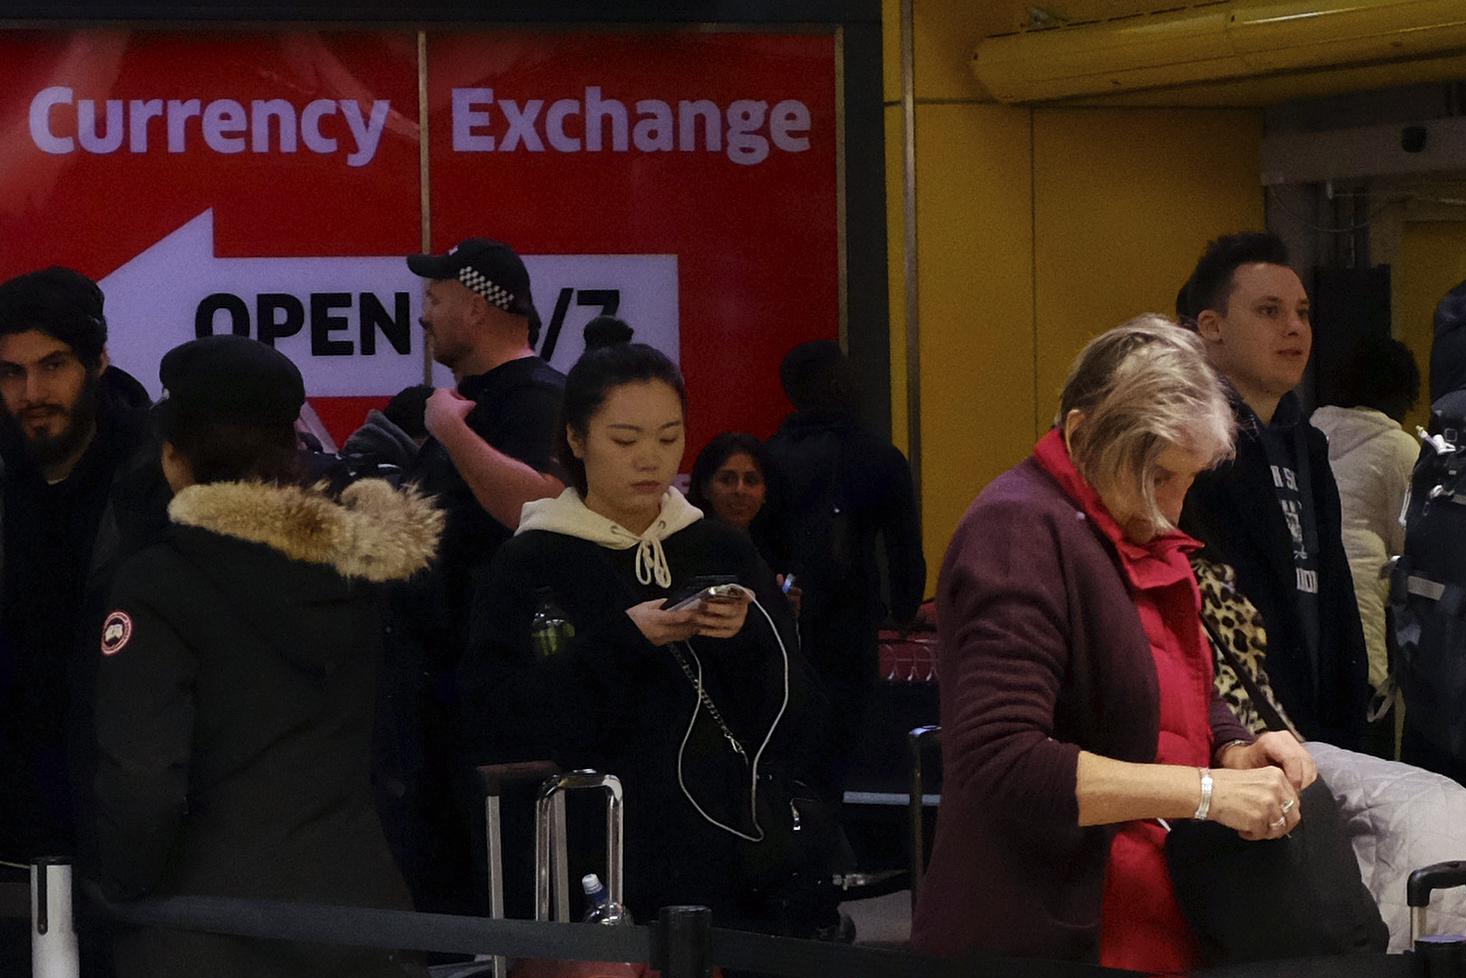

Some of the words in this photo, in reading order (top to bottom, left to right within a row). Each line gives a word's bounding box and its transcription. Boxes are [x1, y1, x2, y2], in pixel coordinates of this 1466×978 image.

[28, 85, 391, 168] Currency
[451, 85, 813, 166] Exchange
[194, 291, 411, 357] OPEN
